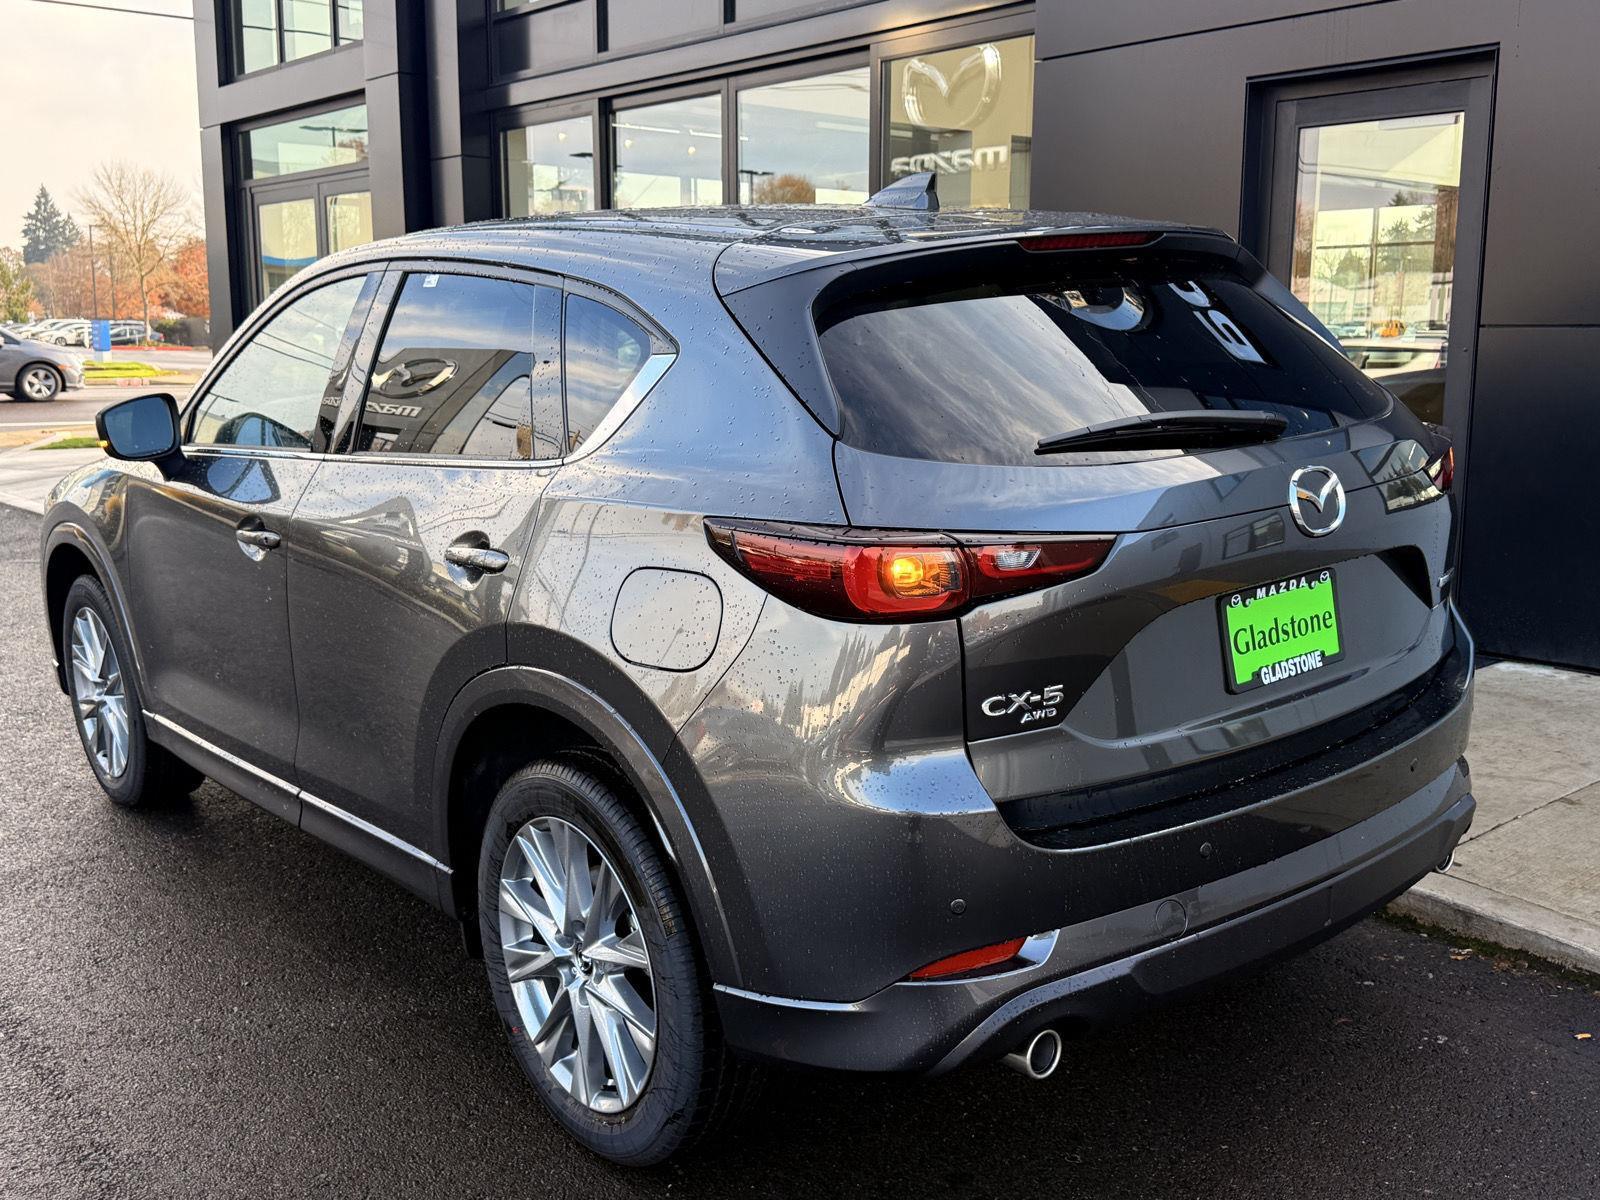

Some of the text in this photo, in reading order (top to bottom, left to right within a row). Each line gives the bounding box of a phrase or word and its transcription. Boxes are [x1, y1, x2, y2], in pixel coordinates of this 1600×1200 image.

[1256, 577, 1307, 599] MAZDA
[1233, 610, 1332, 655] Gladstone
[1261, 651, 1323, 684] GLADSTONE
[982, 684, 1064, 716] CX-5
[1020, 708, 1057, 723] AWD
